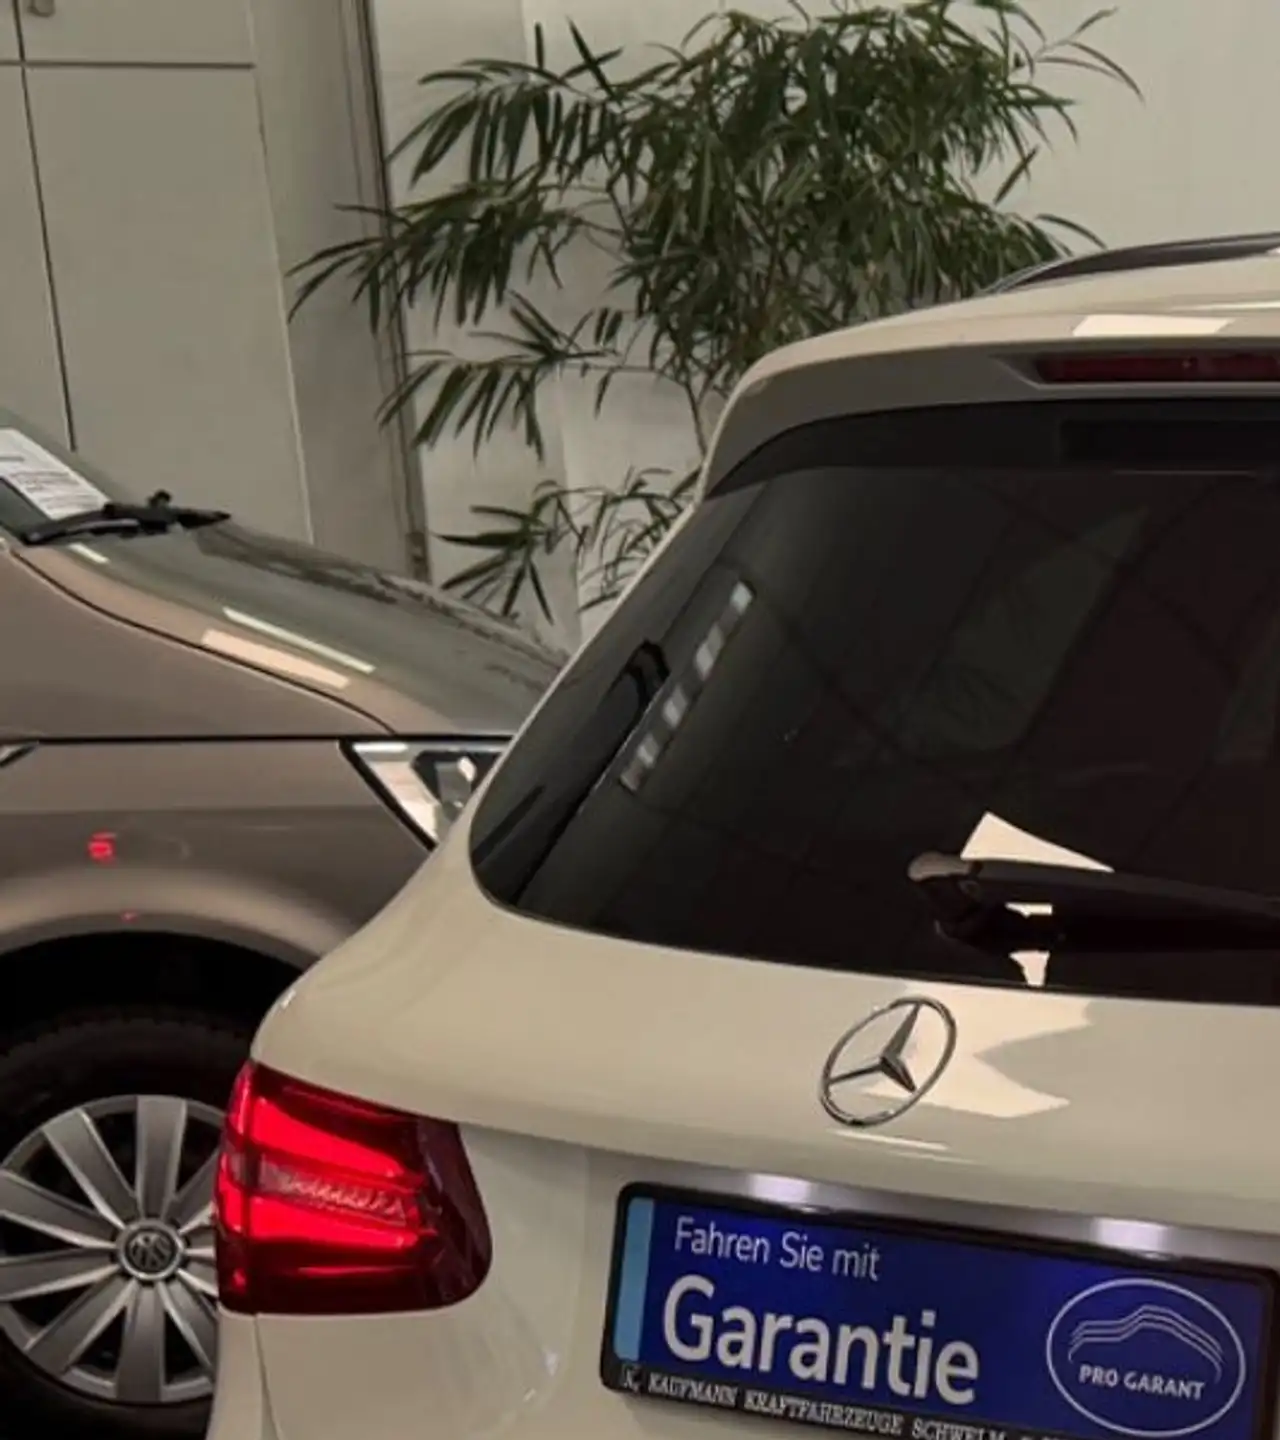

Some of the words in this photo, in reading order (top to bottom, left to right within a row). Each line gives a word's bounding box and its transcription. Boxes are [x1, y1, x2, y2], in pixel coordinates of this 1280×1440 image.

[674, 1216, 771, 1265] Fahren
[780, 1231, 824, 1271] Sie
[832, 1243, 880, 1281] mit
[663, 1274, 979, 1405] Garantie
[648, 1372, 738, 1408] KAUFMANN
[744, 1390, 904, 1435] KRAFTFAHRZEUGE
[1078, 1364, 1118, 1387] PRO
[1123, 1370, 1205, 1400] GARANT
